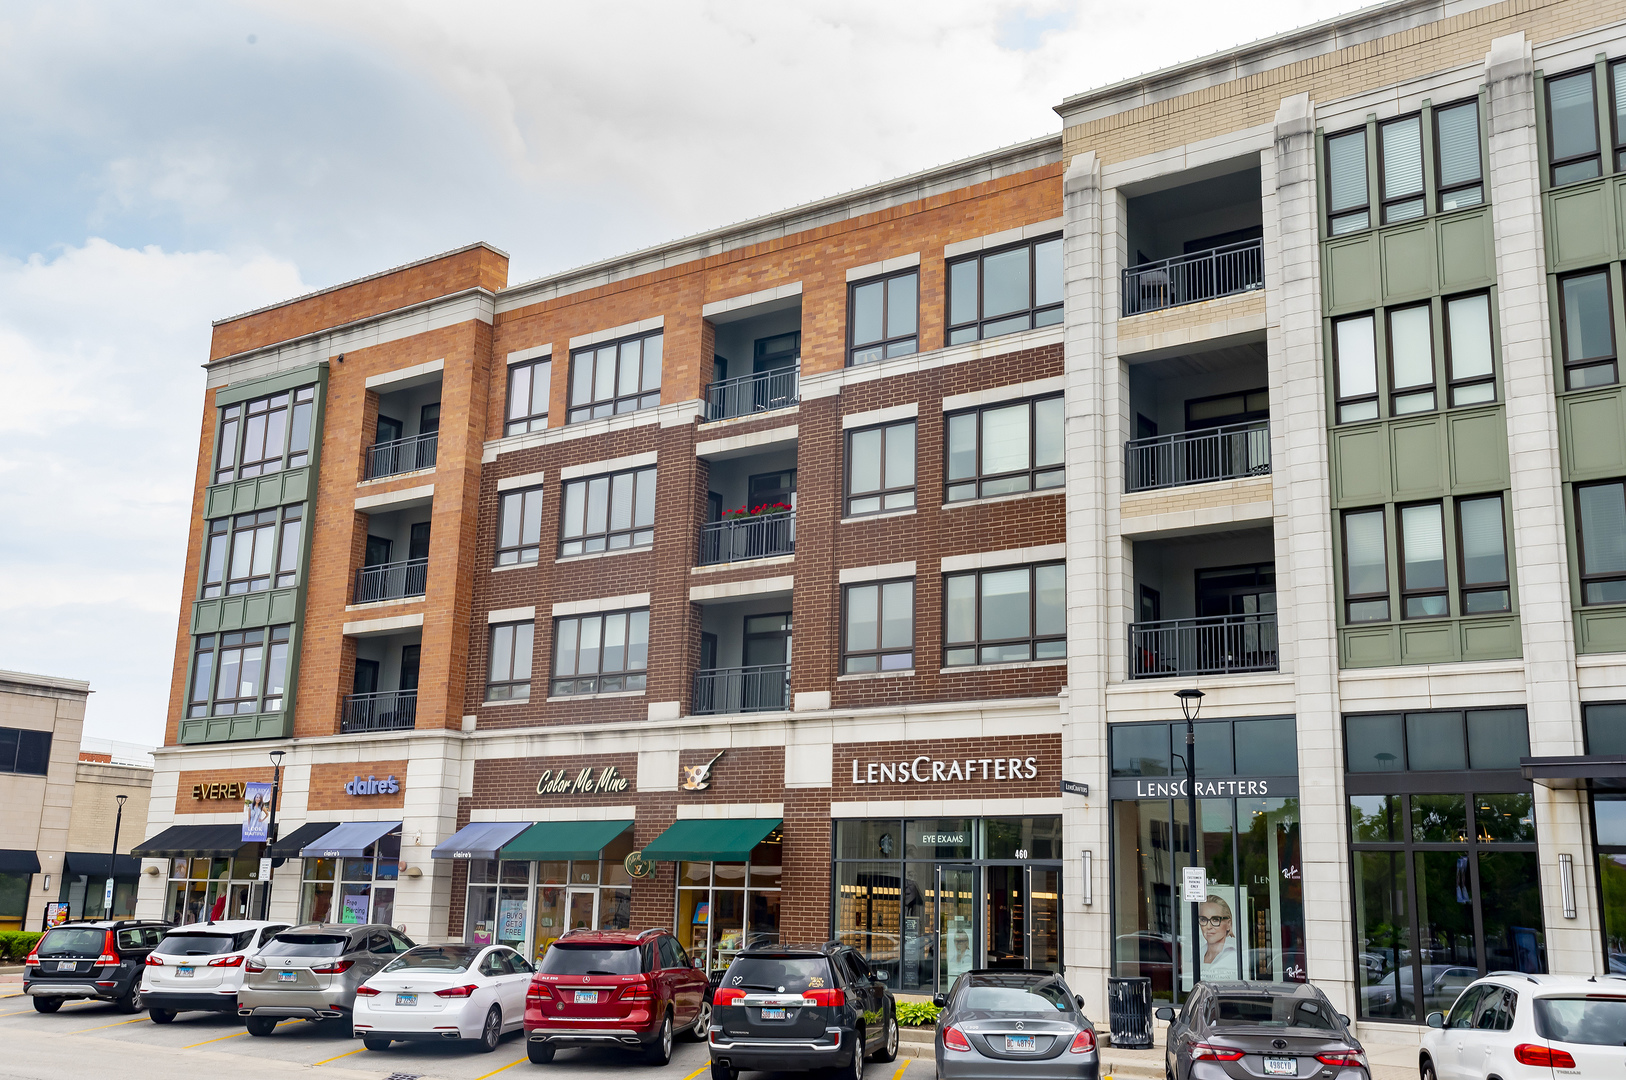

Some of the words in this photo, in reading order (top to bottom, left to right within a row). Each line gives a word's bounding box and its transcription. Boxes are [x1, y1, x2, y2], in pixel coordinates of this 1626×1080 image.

[852, 756, 1038, 784] LENSCRAFTERS
[536, 770, 572, 794] Color
[571, 767, 593, 794] Me
[594, 766, 628, 794] Mine
[346, 775, 400, 795] claire's
[922, 835, 936, 843] EYE
[937, 835, 964, 843] EXAMS
[1014, 849, 1028, 859] 460
[581, 873, 590, 881] 470
[507, 912, 518, 920] BUY
[518, 912, 523, 920] 3
[505, 920, 518, 928] GET
[518, 920, 523, 928] 3
